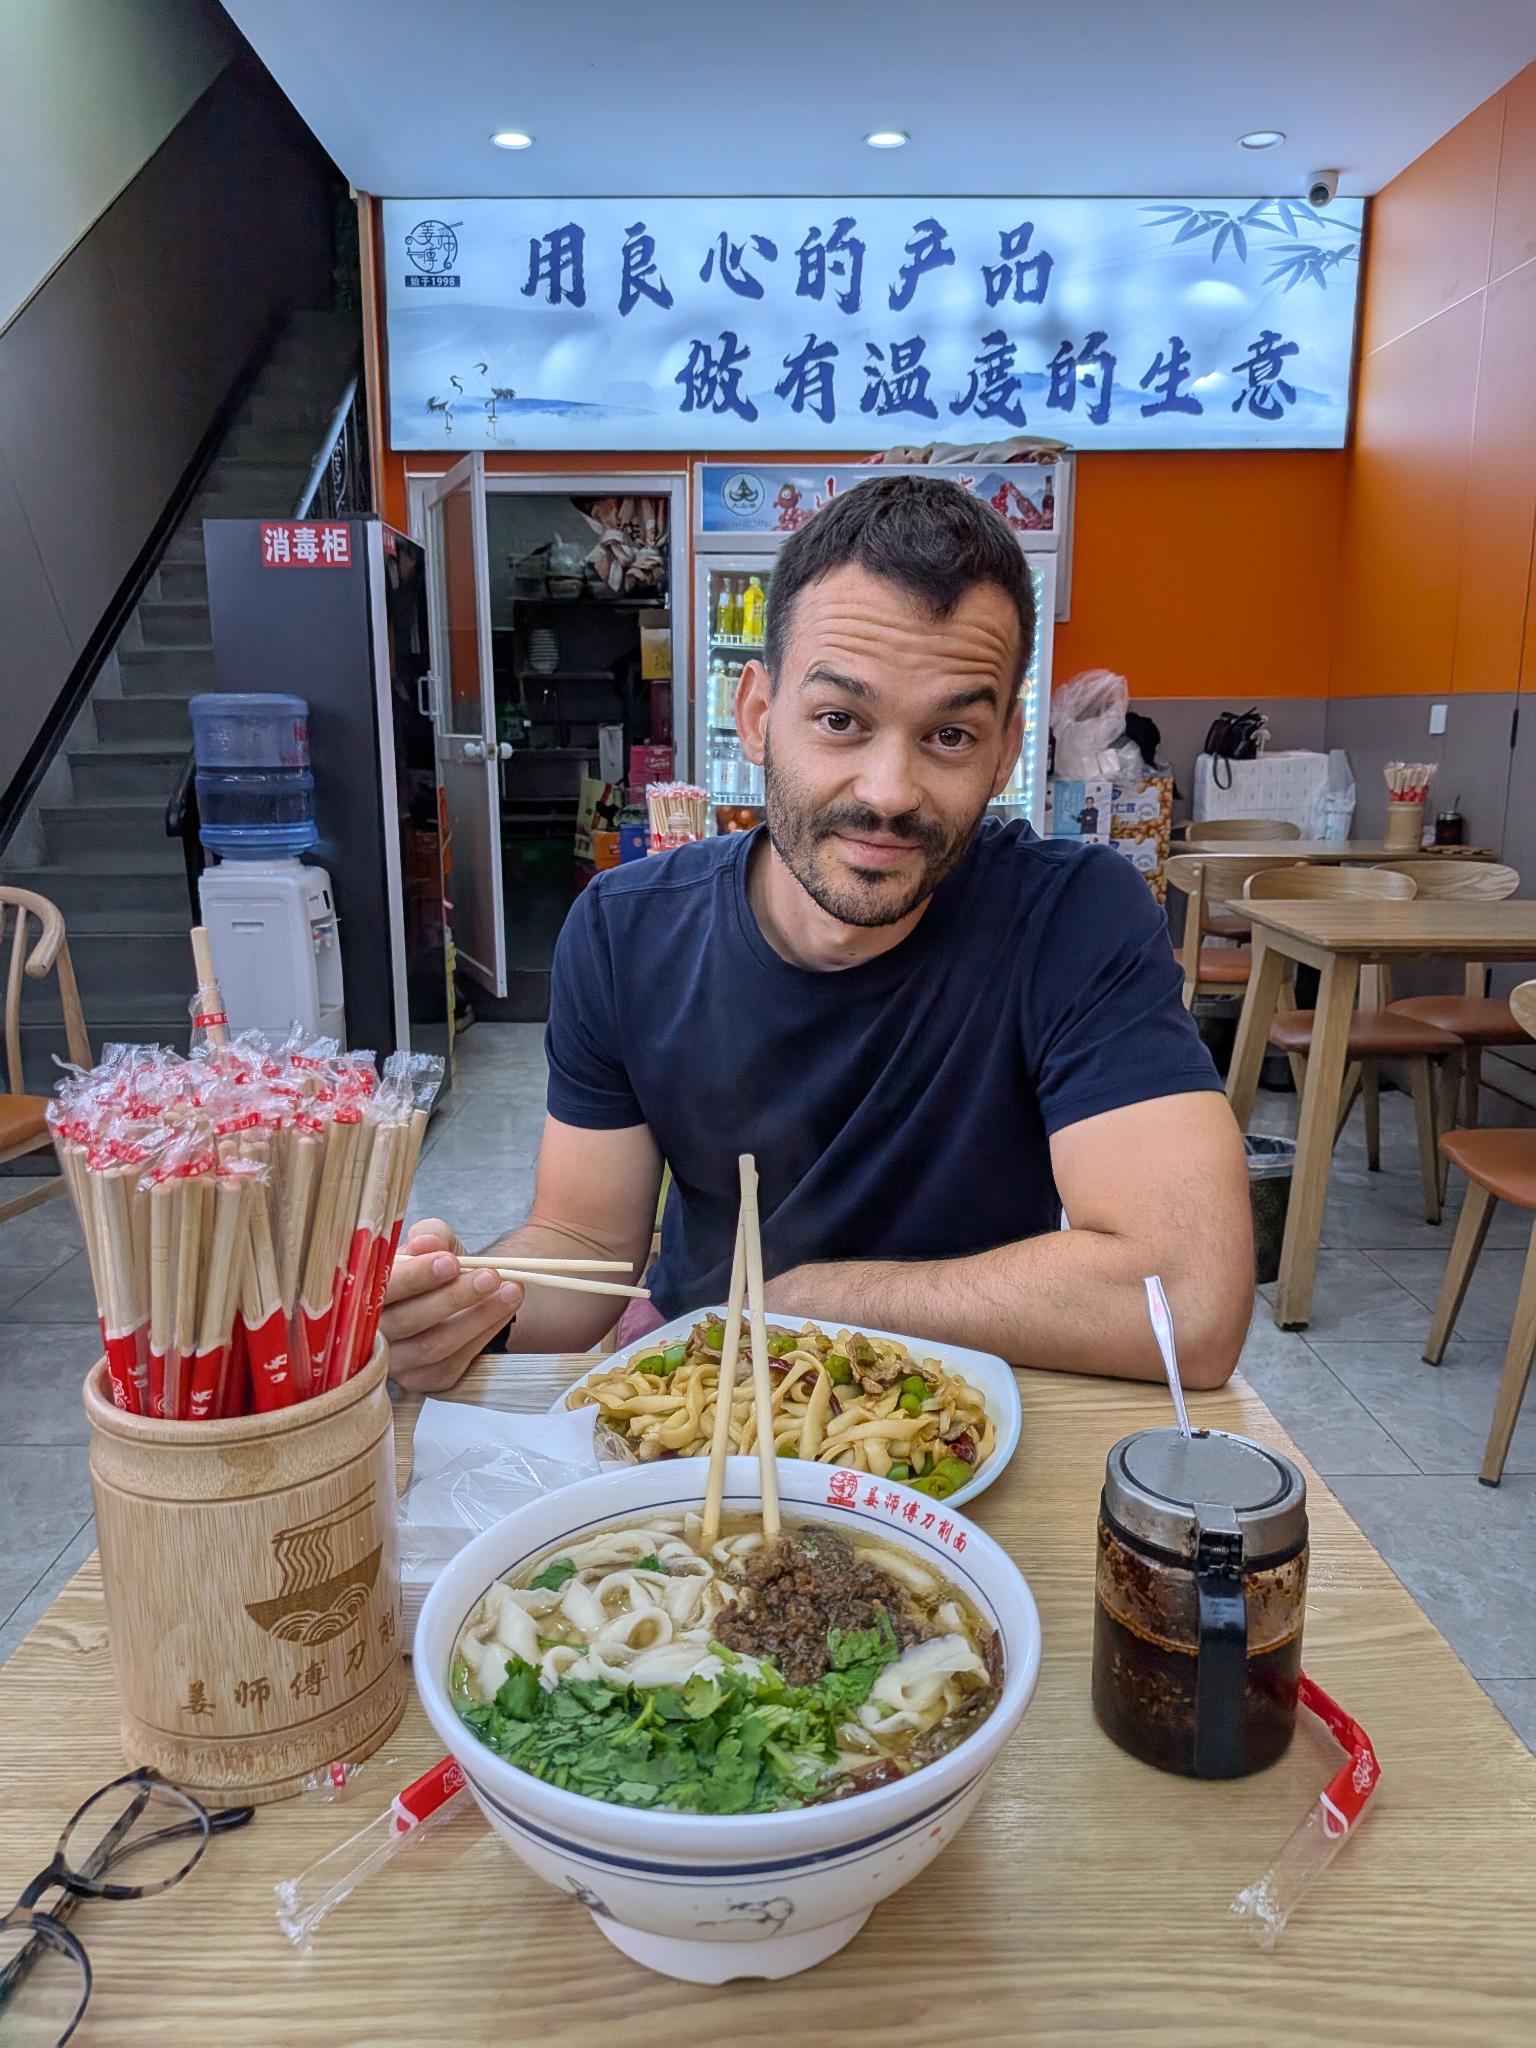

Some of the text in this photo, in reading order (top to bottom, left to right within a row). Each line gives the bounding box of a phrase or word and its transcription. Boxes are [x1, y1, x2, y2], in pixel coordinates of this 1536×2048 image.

[410, 276, 456, 287] 始于1998
[520, 216, 1055, 318] 用良心的产品
[674, 329, 1300, 428] 做有温度的生意
[264, 527, 349, 563] 消毒柜
